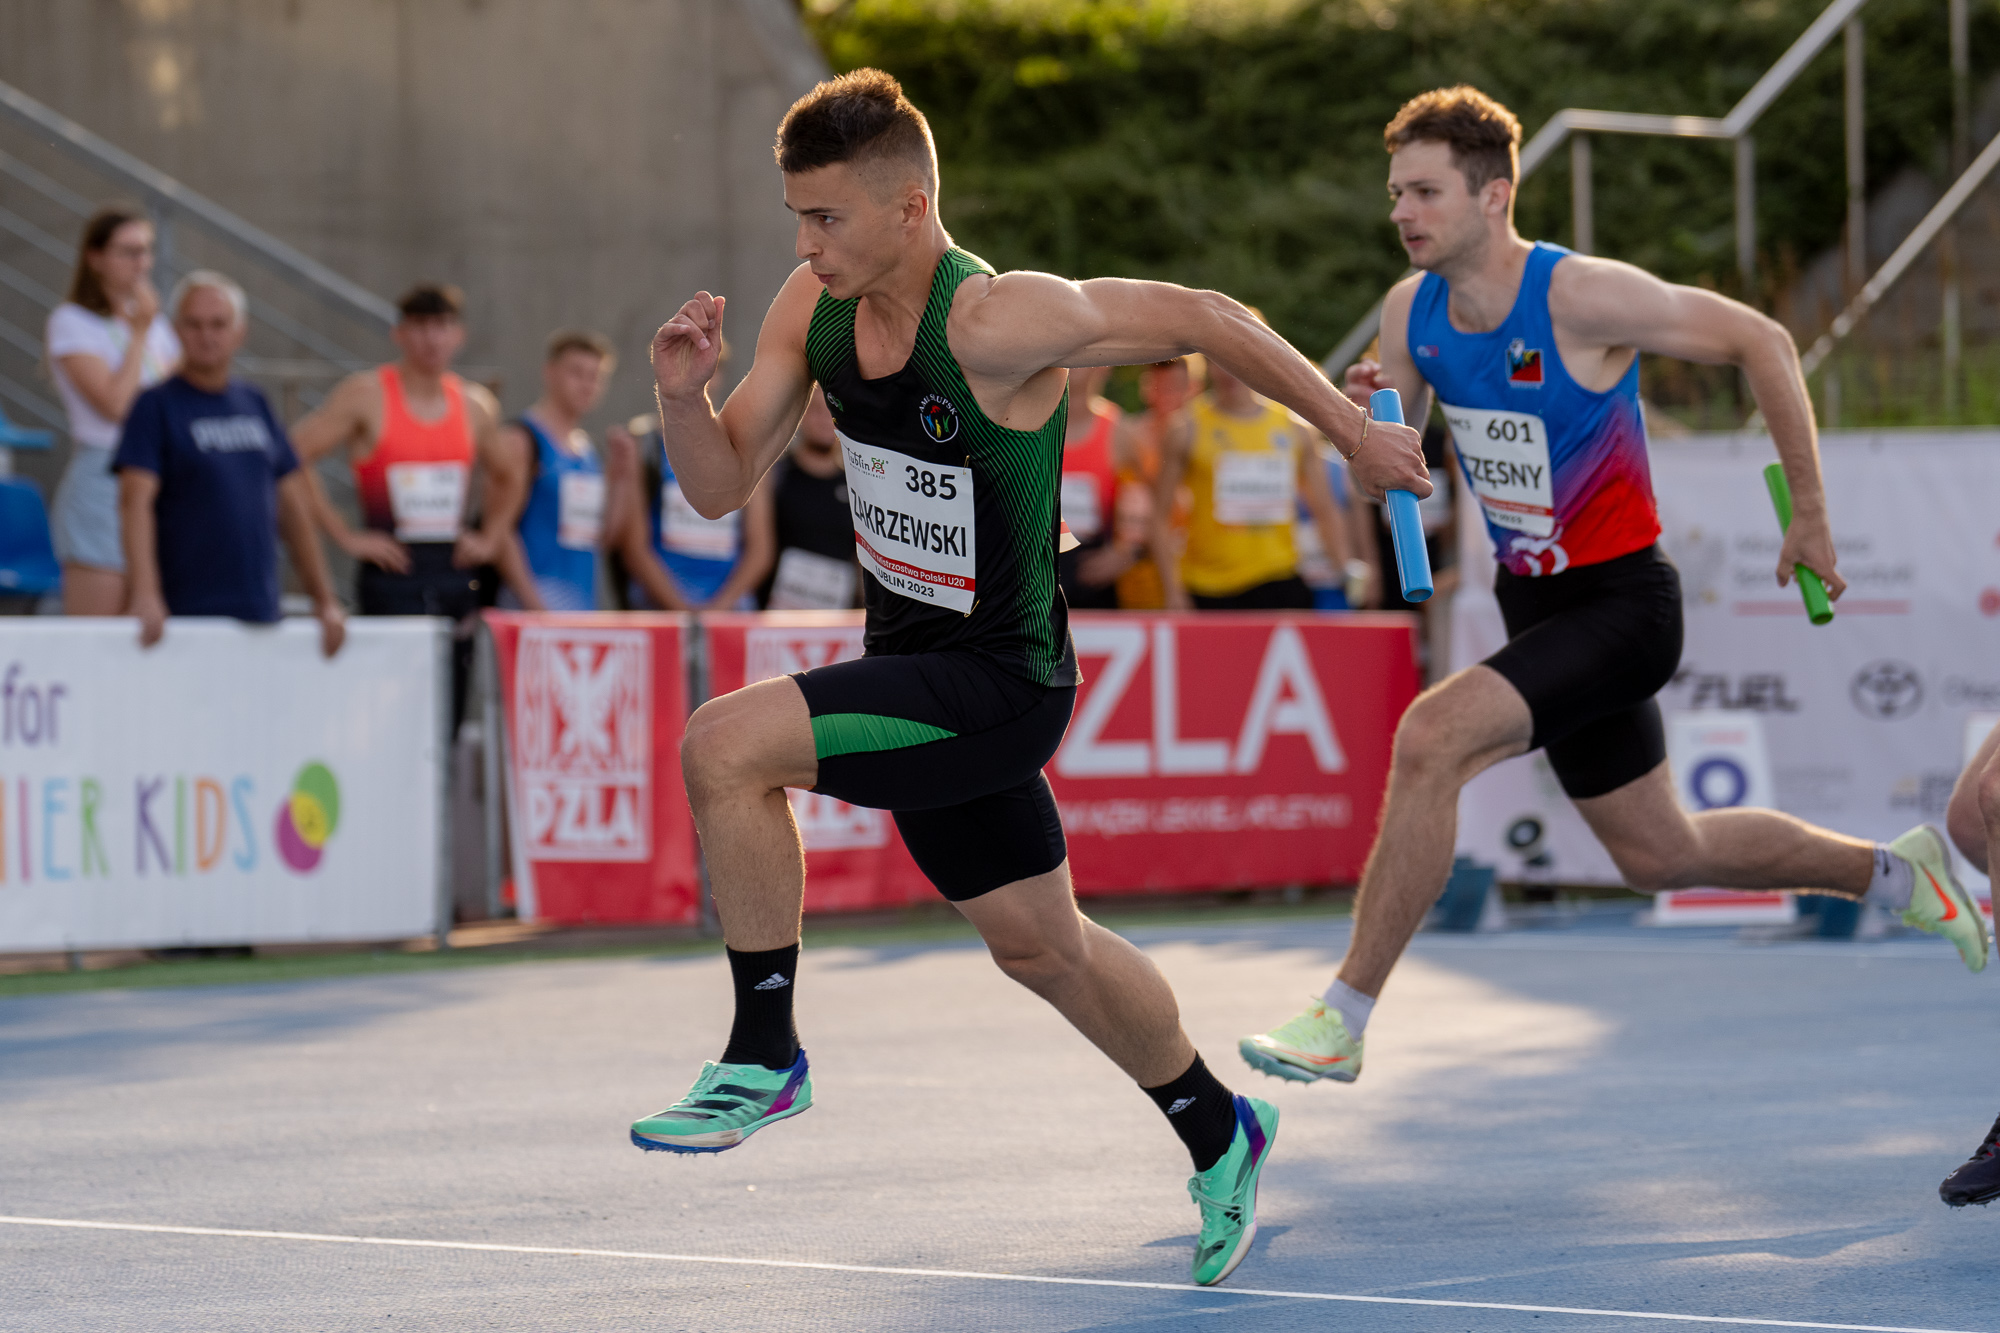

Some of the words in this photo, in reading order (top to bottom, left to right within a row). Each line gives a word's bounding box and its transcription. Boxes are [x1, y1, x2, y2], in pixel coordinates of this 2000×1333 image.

[1486, 418, 1534, 444] 601
[905, 465, 957, 500] 385
[850, 487, 967, 557] ZAKRZEWSKI
[875, 565, 905, 589] LUBLIN
[907, 581, 935, 598] 2023
[920, 570, 946, 584] Polski
[947, 576, 966, 587] U20
[1, 660, 68, 747] for
[1054, 620, 1350, 779] ZLA
[0, 772, 110, 884] IER
[135, 774, 259, 877] KIDS
[753, 979, 790, 990] adidas
